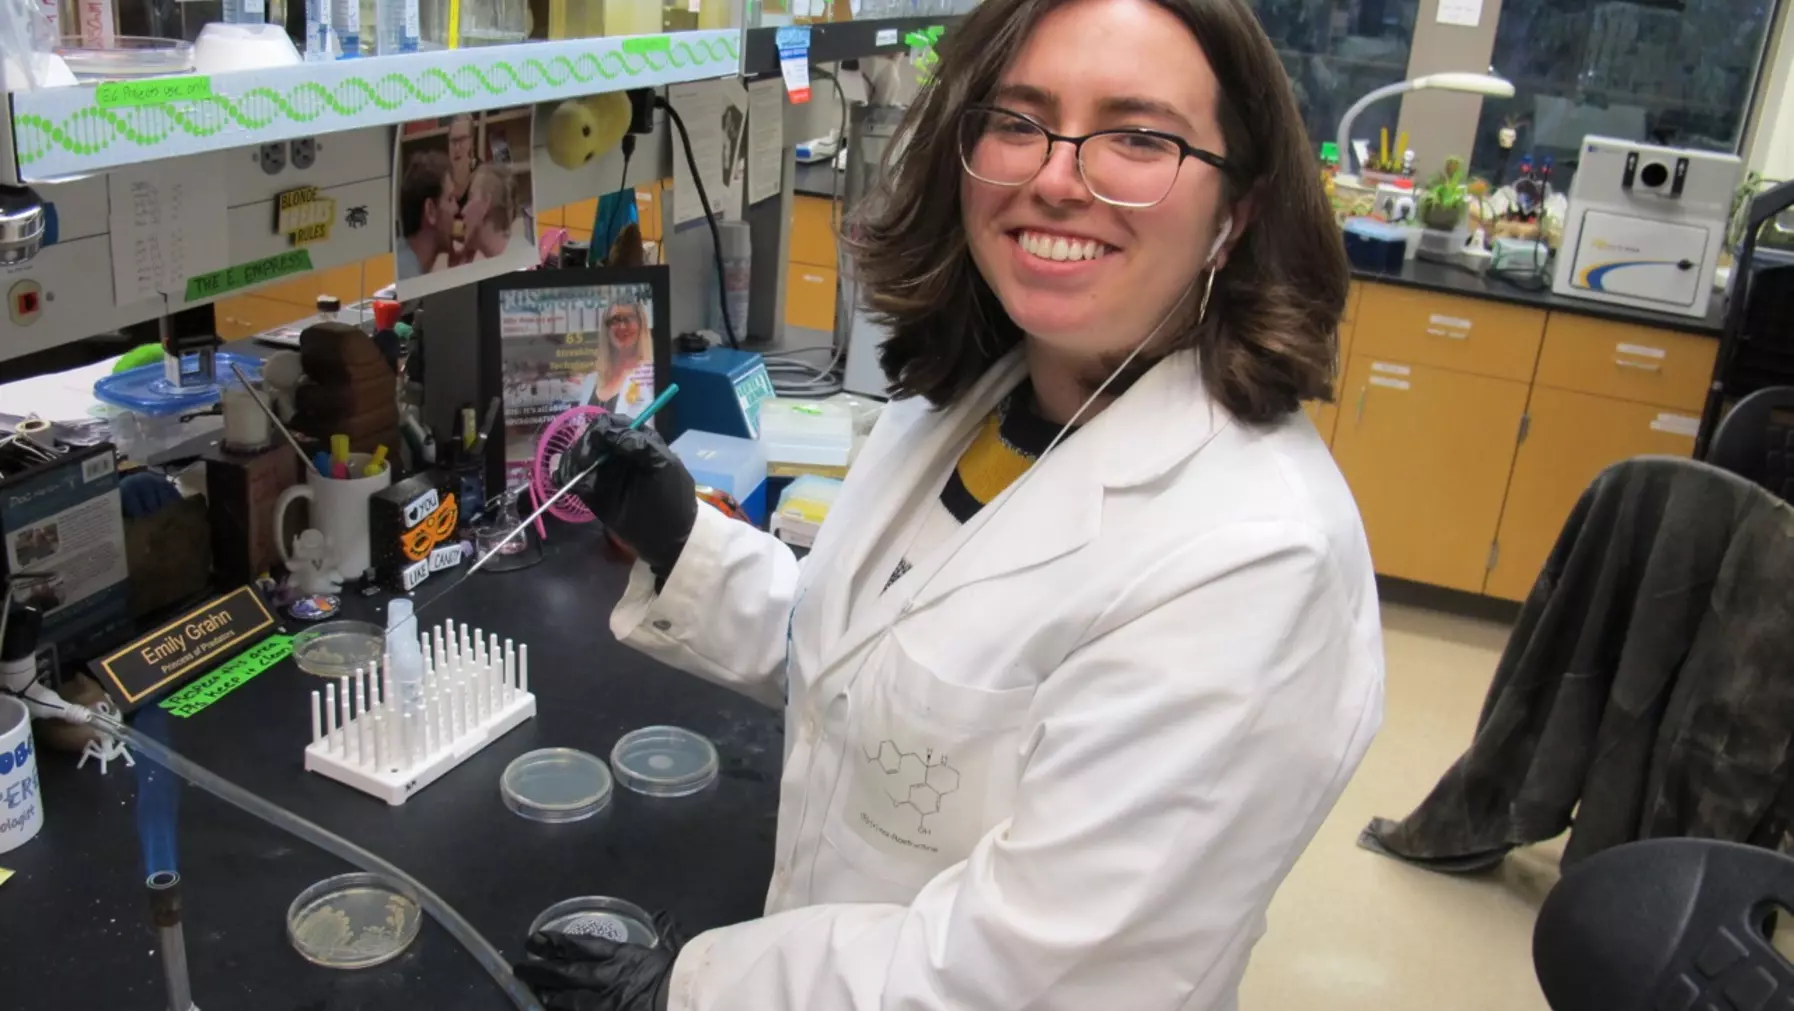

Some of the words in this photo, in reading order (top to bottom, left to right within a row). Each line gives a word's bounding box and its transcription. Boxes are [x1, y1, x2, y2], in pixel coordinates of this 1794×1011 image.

[281, 187, 318, 209] BLONDE
[297, 224, 326, 242] RULES
[194, 274, 220, 292] THE
[244, 252, 304, 283] EMPRESS
[420, 494, 437, 515] YOU
[434, 549, 460, 569] CANDY
[408, 564, 427, 586] LIKE
[141, 633, 187, 666] Emily
[185, 610, 233, 641] Grahn
[161, 652, 195, 674] Princess
[192, 645, 202, 657] of
[200, 629, 236, 652] Predators
